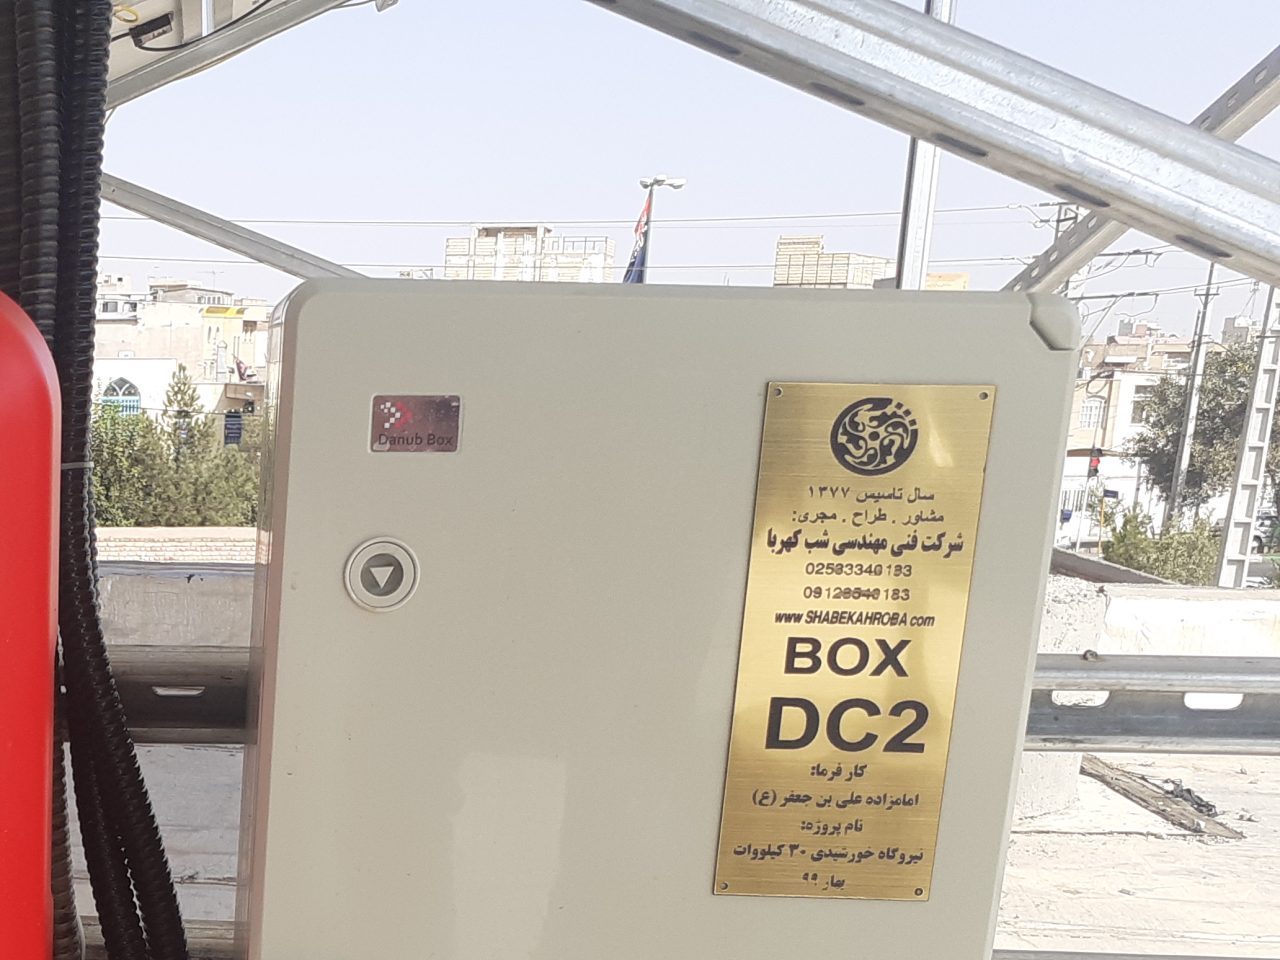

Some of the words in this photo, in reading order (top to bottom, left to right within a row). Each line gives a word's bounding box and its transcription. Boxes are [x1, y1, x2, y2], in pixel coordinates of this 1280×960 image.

[378, 432, 423, 446] Danub
[426, 433, 454, 446] Box
[809, 486, 851, 499] ۱۳۷۷
[855, 487, 903, 503] تاسیس
[907, 487, 935, 503] سال
[851, 507, 888, 526] طراح
[902, 509, 945, 526] مشاور
[766, 528, 802, 556] کهربا
[804, 529, 830, 554] شب
[832, 532, 888, 557] مهندسی
[890, 529, 919, 557] فنی
[920, 531, 964, 559] شرکت
[784, 636, 912, 678] BOX
[765, 697, 930, 754] DC2
[844, 762, 868, 782] کار
[779, 790, 813, 808] جعفر
[815, 794, 832, 809] بن
[835, 791, 862, 809] علی
[865, 793, 920, 810] امامزاده
[844, 818, 863, 836] نام
[878, 847, 924, 865] نیروگاه
